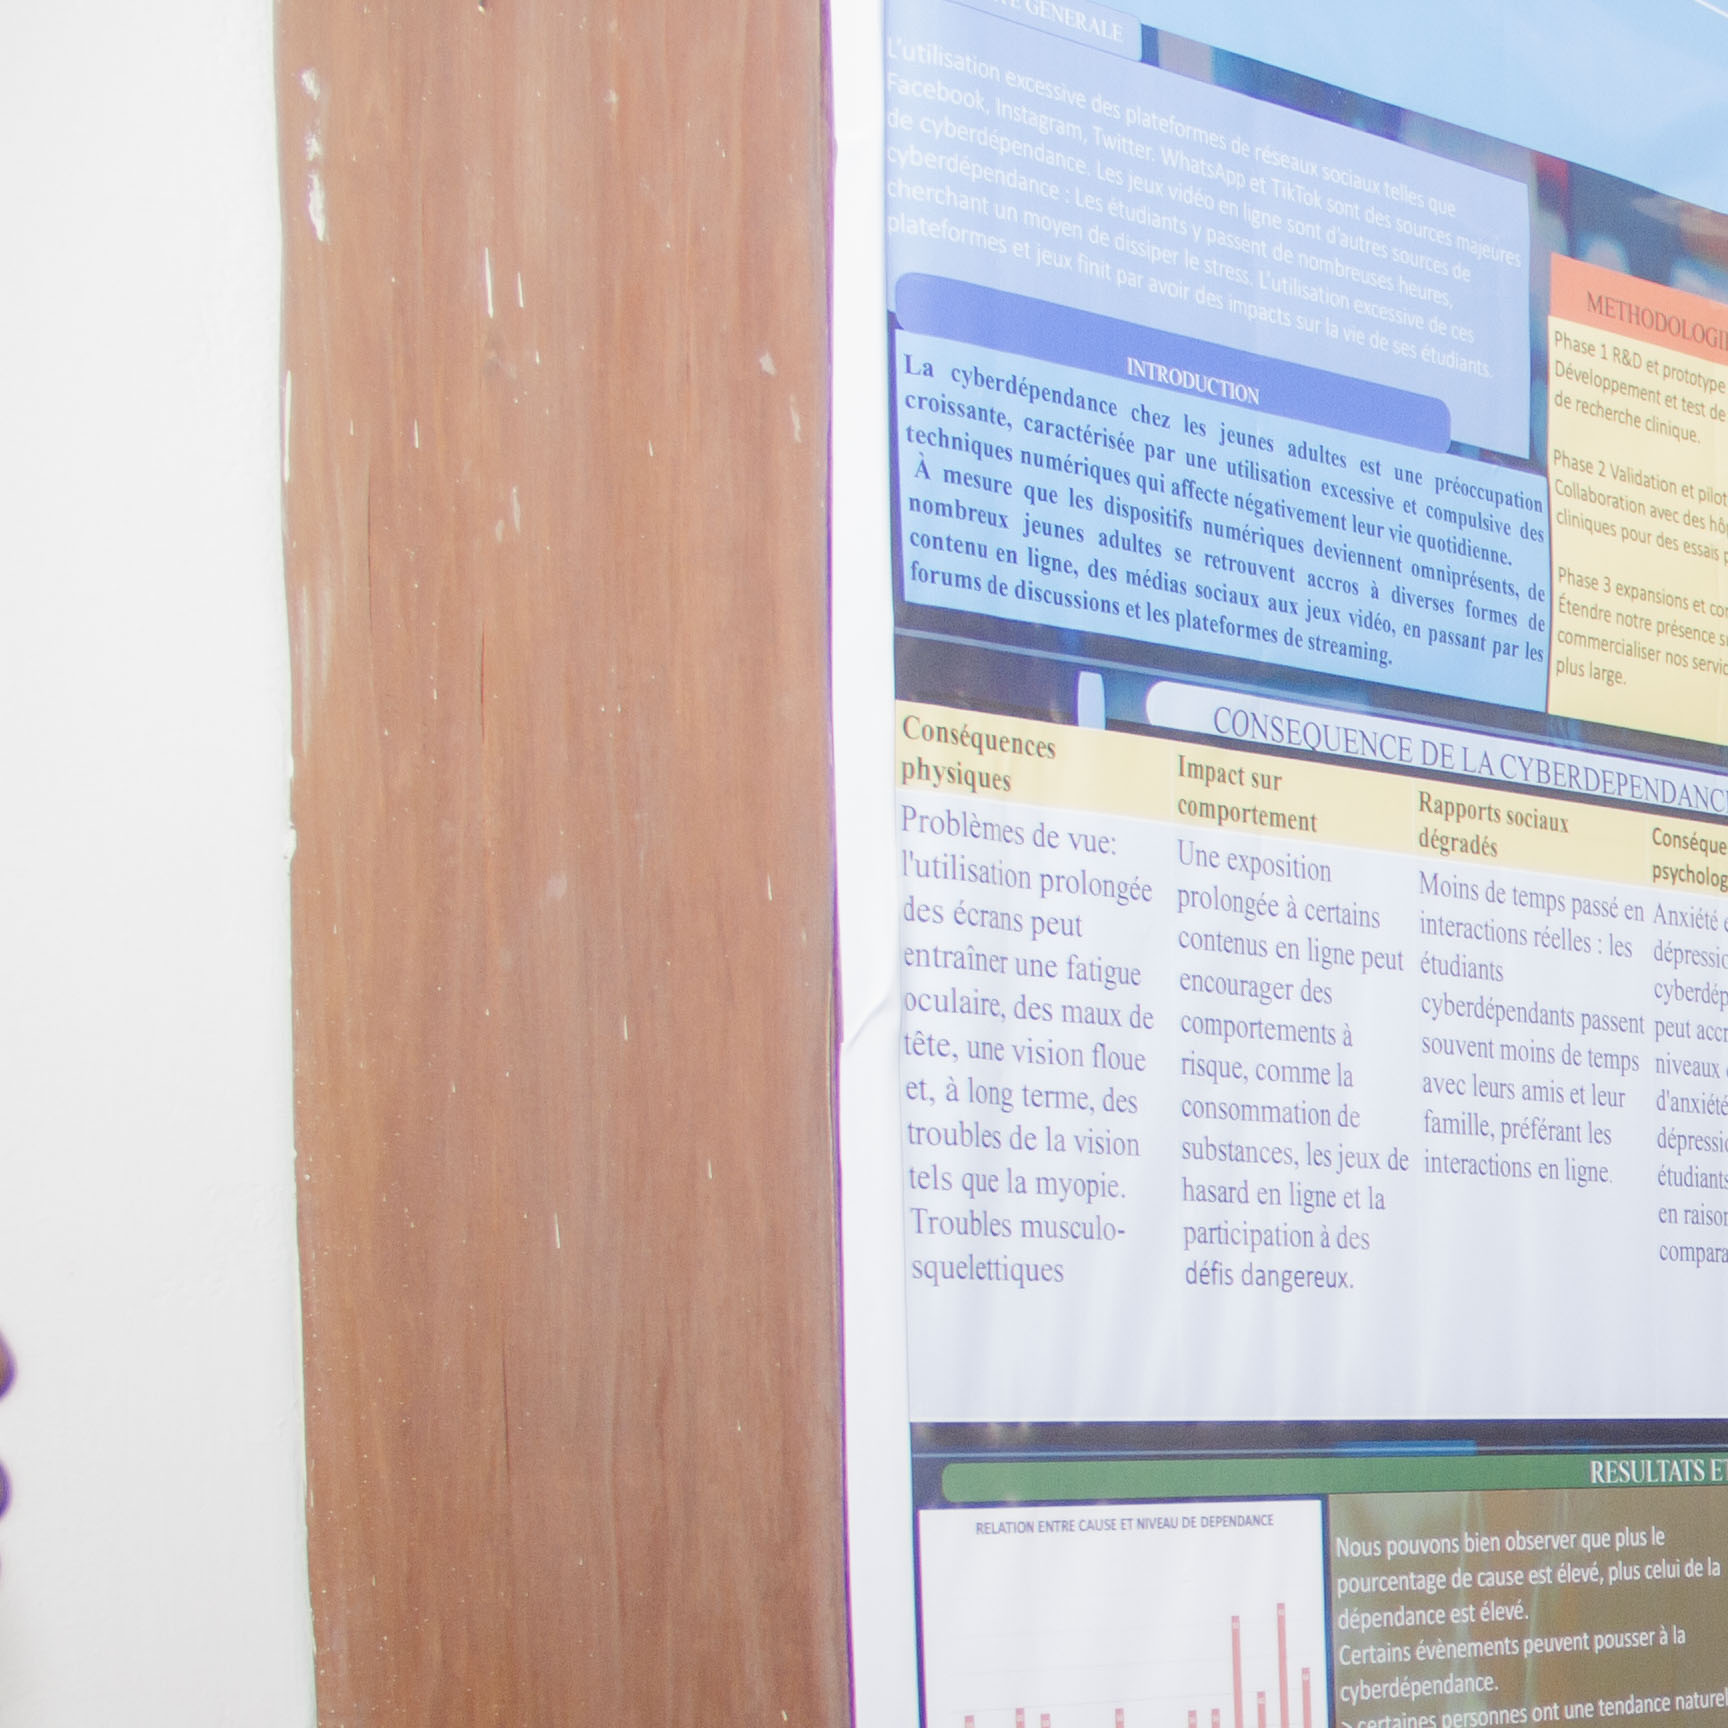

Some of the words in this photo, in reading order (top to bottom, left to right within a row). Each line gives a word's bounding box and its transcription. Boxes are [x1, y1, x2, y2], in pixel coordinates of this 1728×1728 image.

[1005, 66, 1087, 109] excessive
[1090, 92, 1121, 120] des
[1125, 105, 1227, 151] plateformes
[1230, 135, 1251, 159] de
[1253, 143, 1319, 178] réseaux
[1321, 165, 1381, 196] sociaux
[1383, 180, 1425, 209] telles
[1427, 196, 1457, 218] que
[1127, 356, 1260, 406] INTRODUCTION
[1554, 358, 1662, 406] Développement
[1664, 394, 1678, 411] et
[1680, 396, 1706, 419] test
[1709, 403, 1727, 423] de
[904, 353, 935, 378] La
[950, 365, 1118, 417] cyberdépendance
[1130, 403, 1171, 429] chez
[1183, 413, 1207, 437] les
[1218, 421, 1274, 453] jeunes
[1287, 440, 1347, 469] adultes
[1359, 459, 1381, 477] est
[1394, 466, 1423, 486] une
[1434, 475, 1543, 514] préoccupation
[1555, 655, 1585, 678] plus
[1588, 661, 1626, 688] large.
[902, 714, 1056, 759] Conséquences
[1213, 705, 1414, 764] CONSEQUENCE
[1420, 741, 1455, 771] DE
[1461, 747, 1494, 777] LA
[901, 755, 1012, 795] physiques
[1178, 754, 1245, 789] Impact
[1251, 772, 1283, 791] sur
[1177, 797, 1317, 833] comportement
[1418, 826, 1498, 858] dégradés
[1185, 1259, 1234, 1286] défis
[1240, 1262, 1354, 1294] dangereux.
[1590, 1458, 1706, 1484] RESULTATS
[975, 1520, 1035, 1535] RELATION
[1037, 1519, 1075, 1534] ENTRE
[1077, 1518, 1117, 1533] CAUSE
[1120, 1517, 1134, 1532] ET
[1136, 1516, 1179, 1530] NIVEAU
[1181, 1515, 1197, 1529] DE
[1200, 1513, 1274, 1529] DEPENDANCE
[1339, 1671, 1499, 1706] cyberdépendance.
